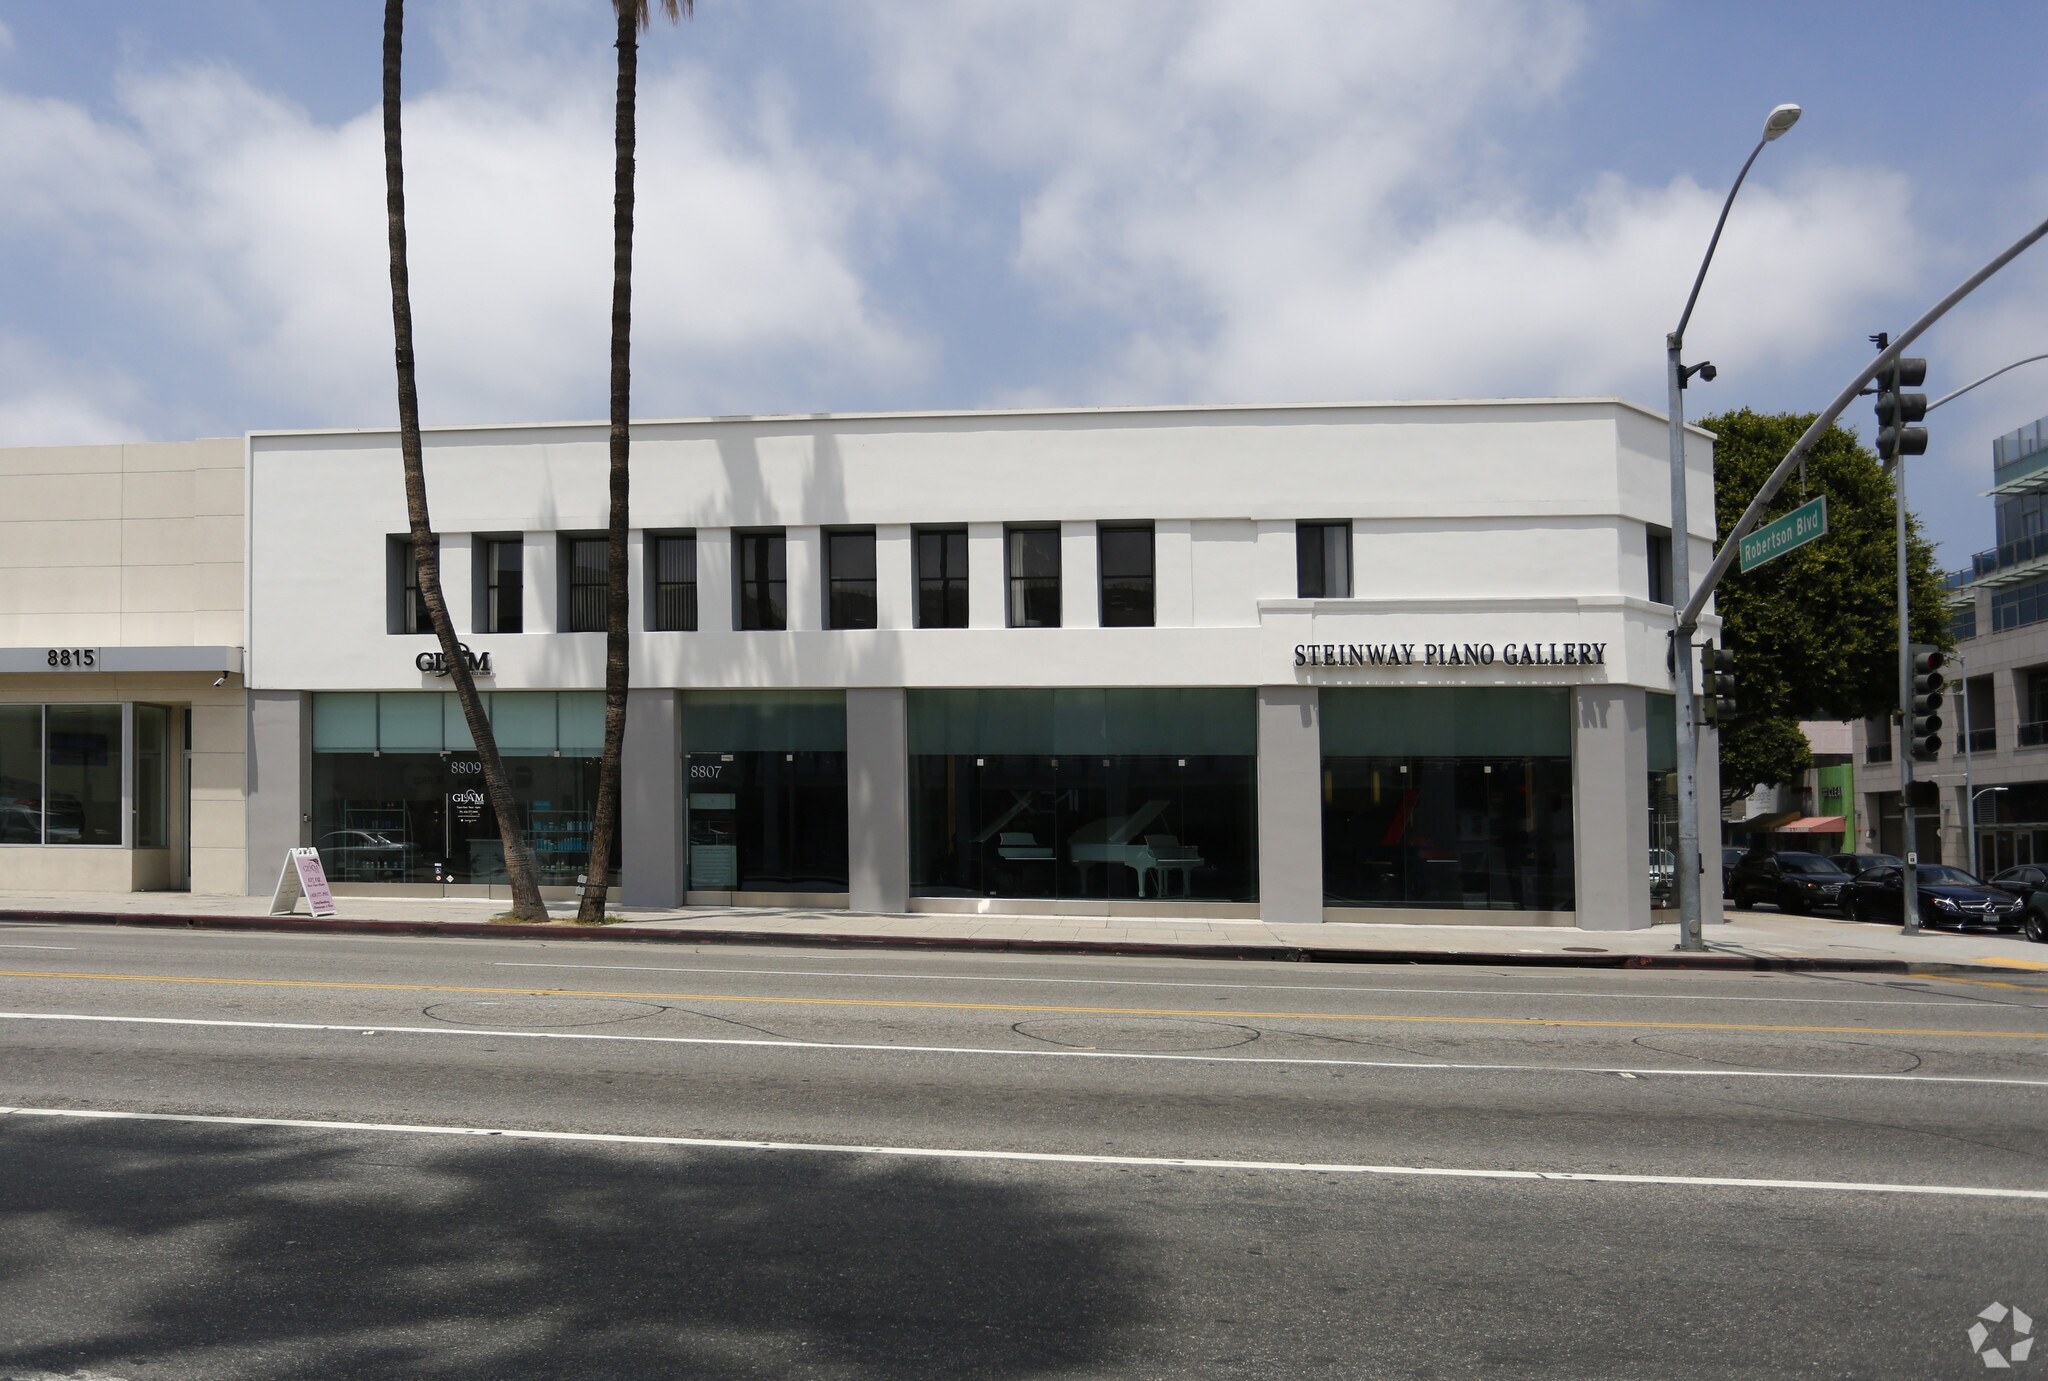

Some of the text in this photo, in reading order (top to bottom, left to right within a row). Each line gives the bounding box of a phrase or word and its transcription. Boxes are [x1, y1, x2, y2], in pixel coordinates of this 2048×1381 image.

[1745, 509, 1819, 562] Robertson Blvd
[47, 649, 94, 666] 8815
[416, 645, 490, 674] GLM
[1294, 642, 1607, 666] STEINWAY PIANO GALLERY
[451, 761, 482, 774] 8809
[690, 765, 722, 778] 8807
[452, 790, 484, 803] GLAM
